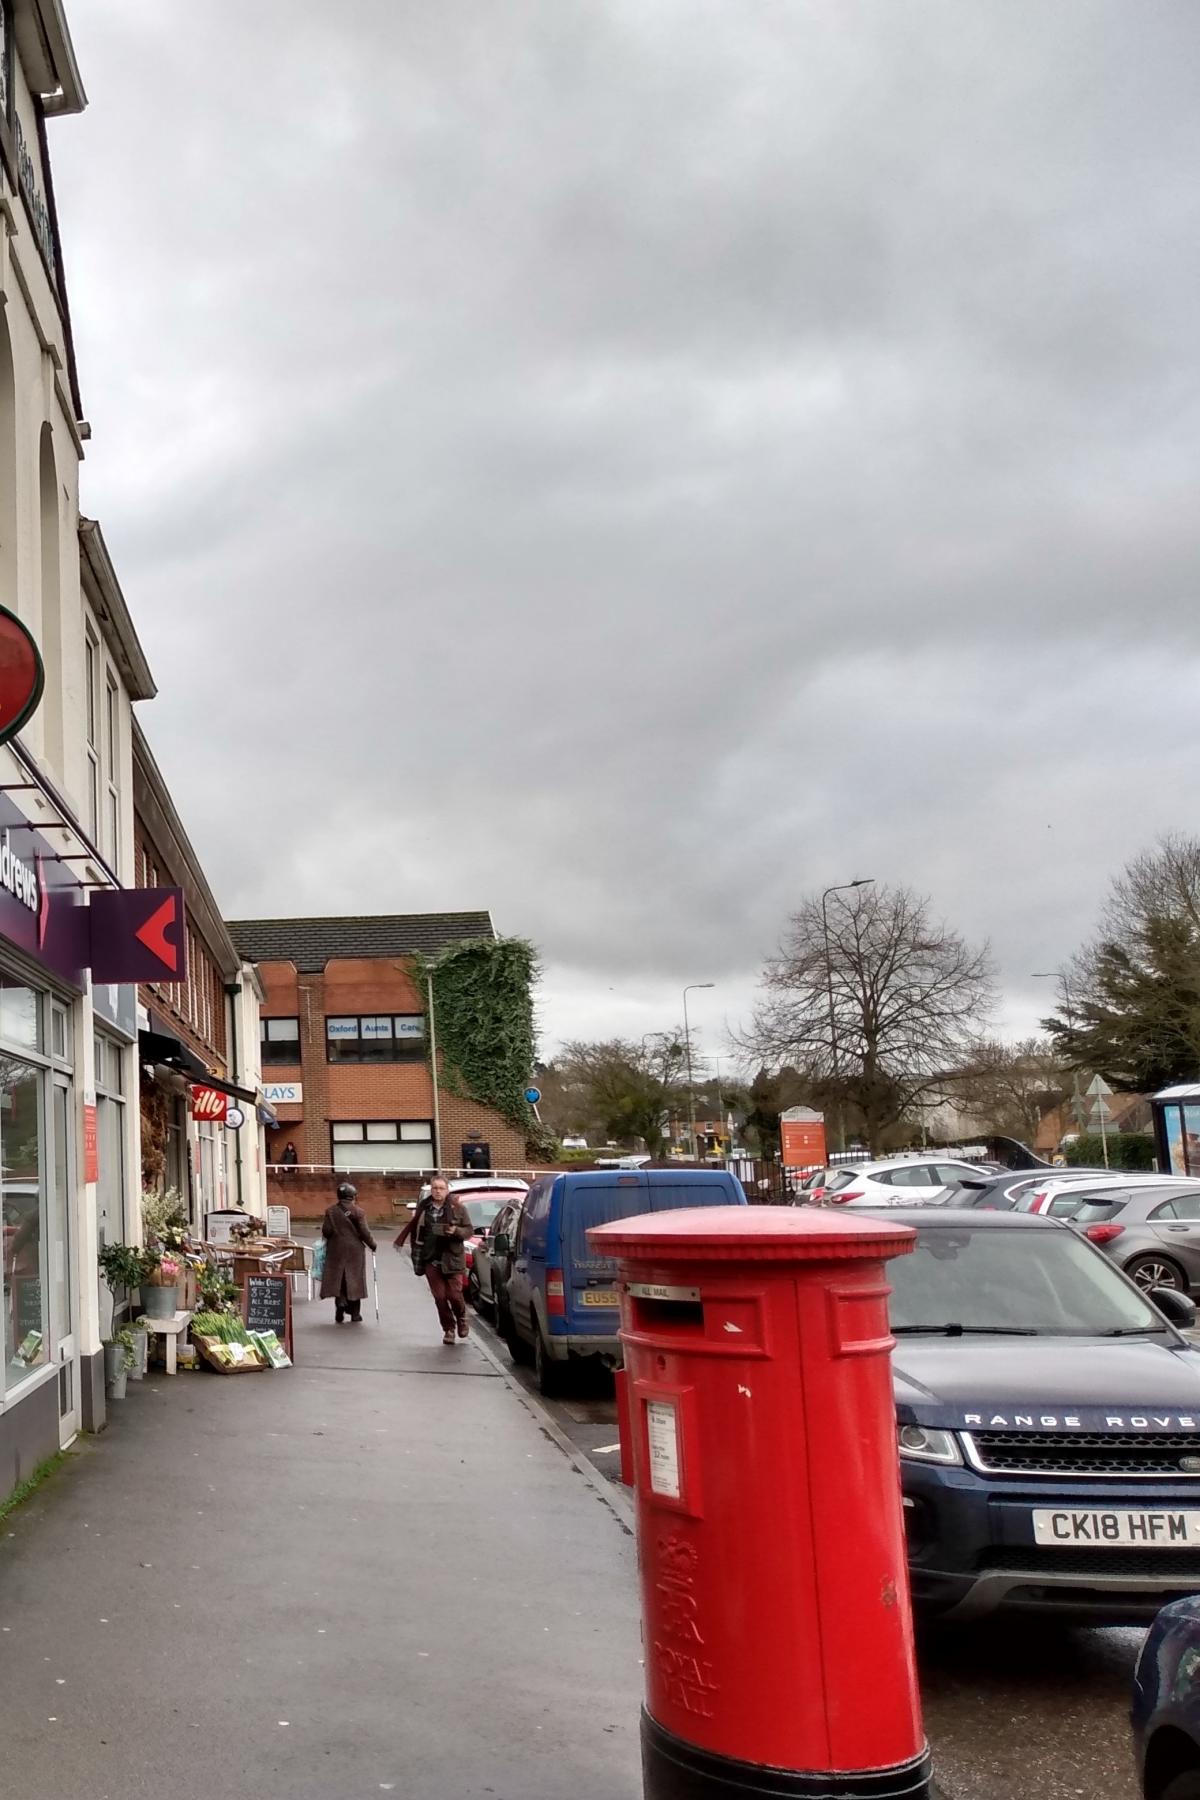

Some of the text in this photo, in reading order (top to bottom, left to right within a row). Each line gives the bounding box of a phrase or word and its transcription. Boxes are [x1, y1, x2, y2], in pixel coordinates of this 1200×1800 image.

[329, 1025, 358, 1033] Oxford
[364, 1024, 389, 1032] Aunts
[193, 1091, 225, 1118] illy
[653, 1288, 669, 1297] MAIL
[964, 1414, 1195, 1428] RANGE ROVE
[1052, 1513, 1187, 1541] CK18 HFM
